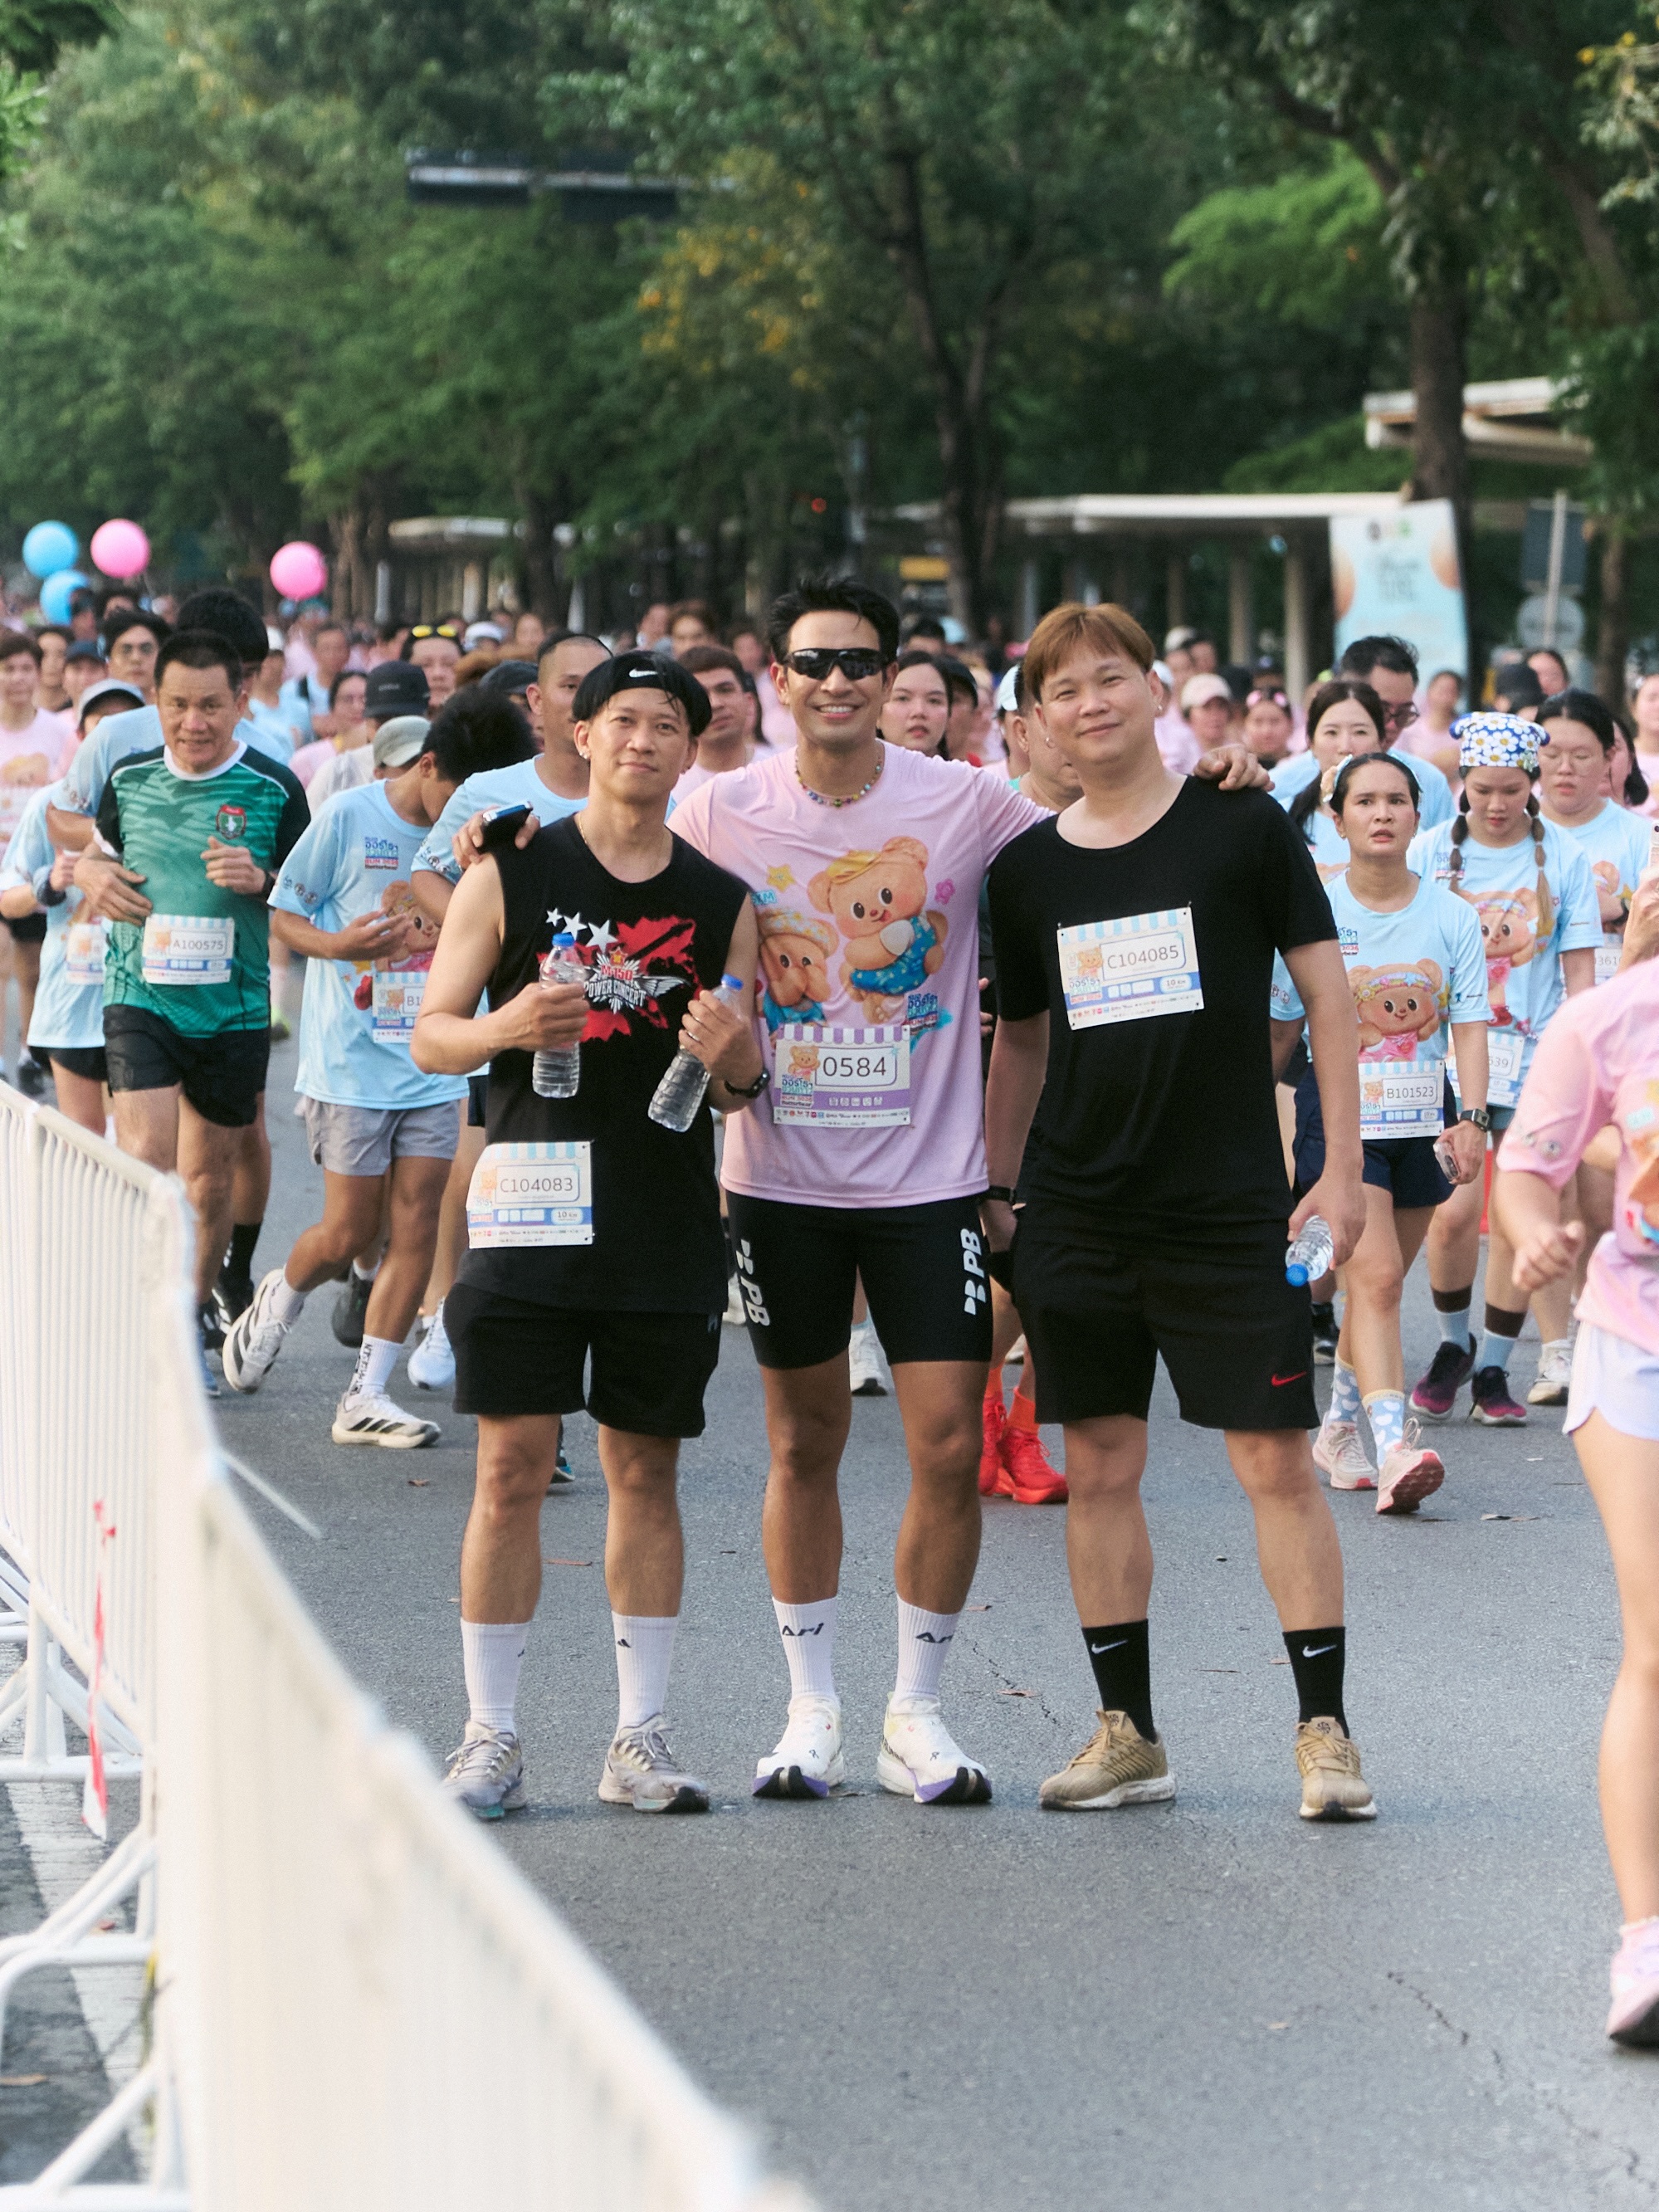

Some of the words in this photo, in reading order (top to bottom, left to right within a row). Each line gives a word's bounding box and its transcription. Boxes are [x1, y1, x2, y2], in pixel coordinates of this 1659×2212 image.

[173, 939, 224, 950] A100575
[1107, 945, 1179, 969] C104085
[583, 979, 612, 998] POWER
[613, 978, 647, 1008] CONCERT
[822, 1057, 886, 1077] 0584
[1387, 1086, 1434, 1099] B101523
[500, 1177, 573, 1193] C104083
